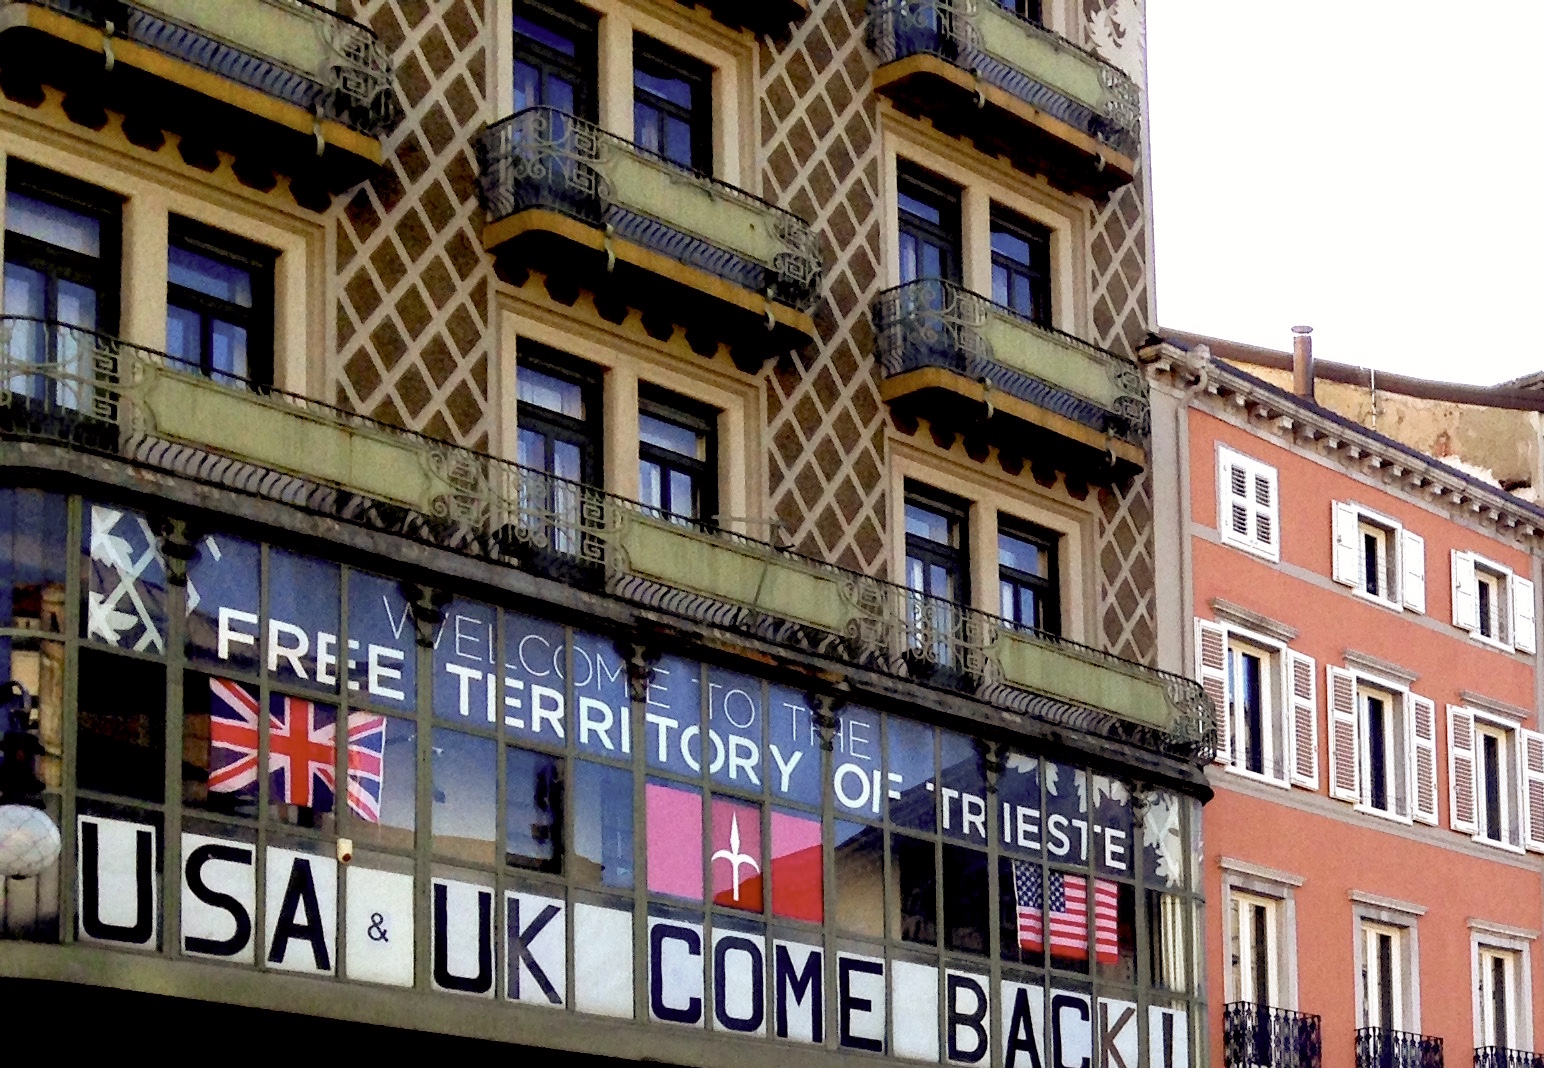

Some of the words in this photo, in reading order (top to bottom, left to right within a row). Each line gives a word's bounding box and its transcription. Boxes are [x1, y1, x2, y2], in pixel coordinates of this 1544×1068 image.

[218, 607, 405, 701] FREE
[446, 662, 803, 793] TERRITORY
[834, 763, 903, 814] OF
[926, 782, 1127, 871] TRIESTE
[383, 595, 671, 709] WELCOME
[692, 679, 756, 728] TO
[783, 702, 871, 760] THE
[80, 821, 332, 971] USA
[366, 912, 389, 943] &
[432, 883, 563, 1005] UK
[649, 923, 884, 1052] COME
